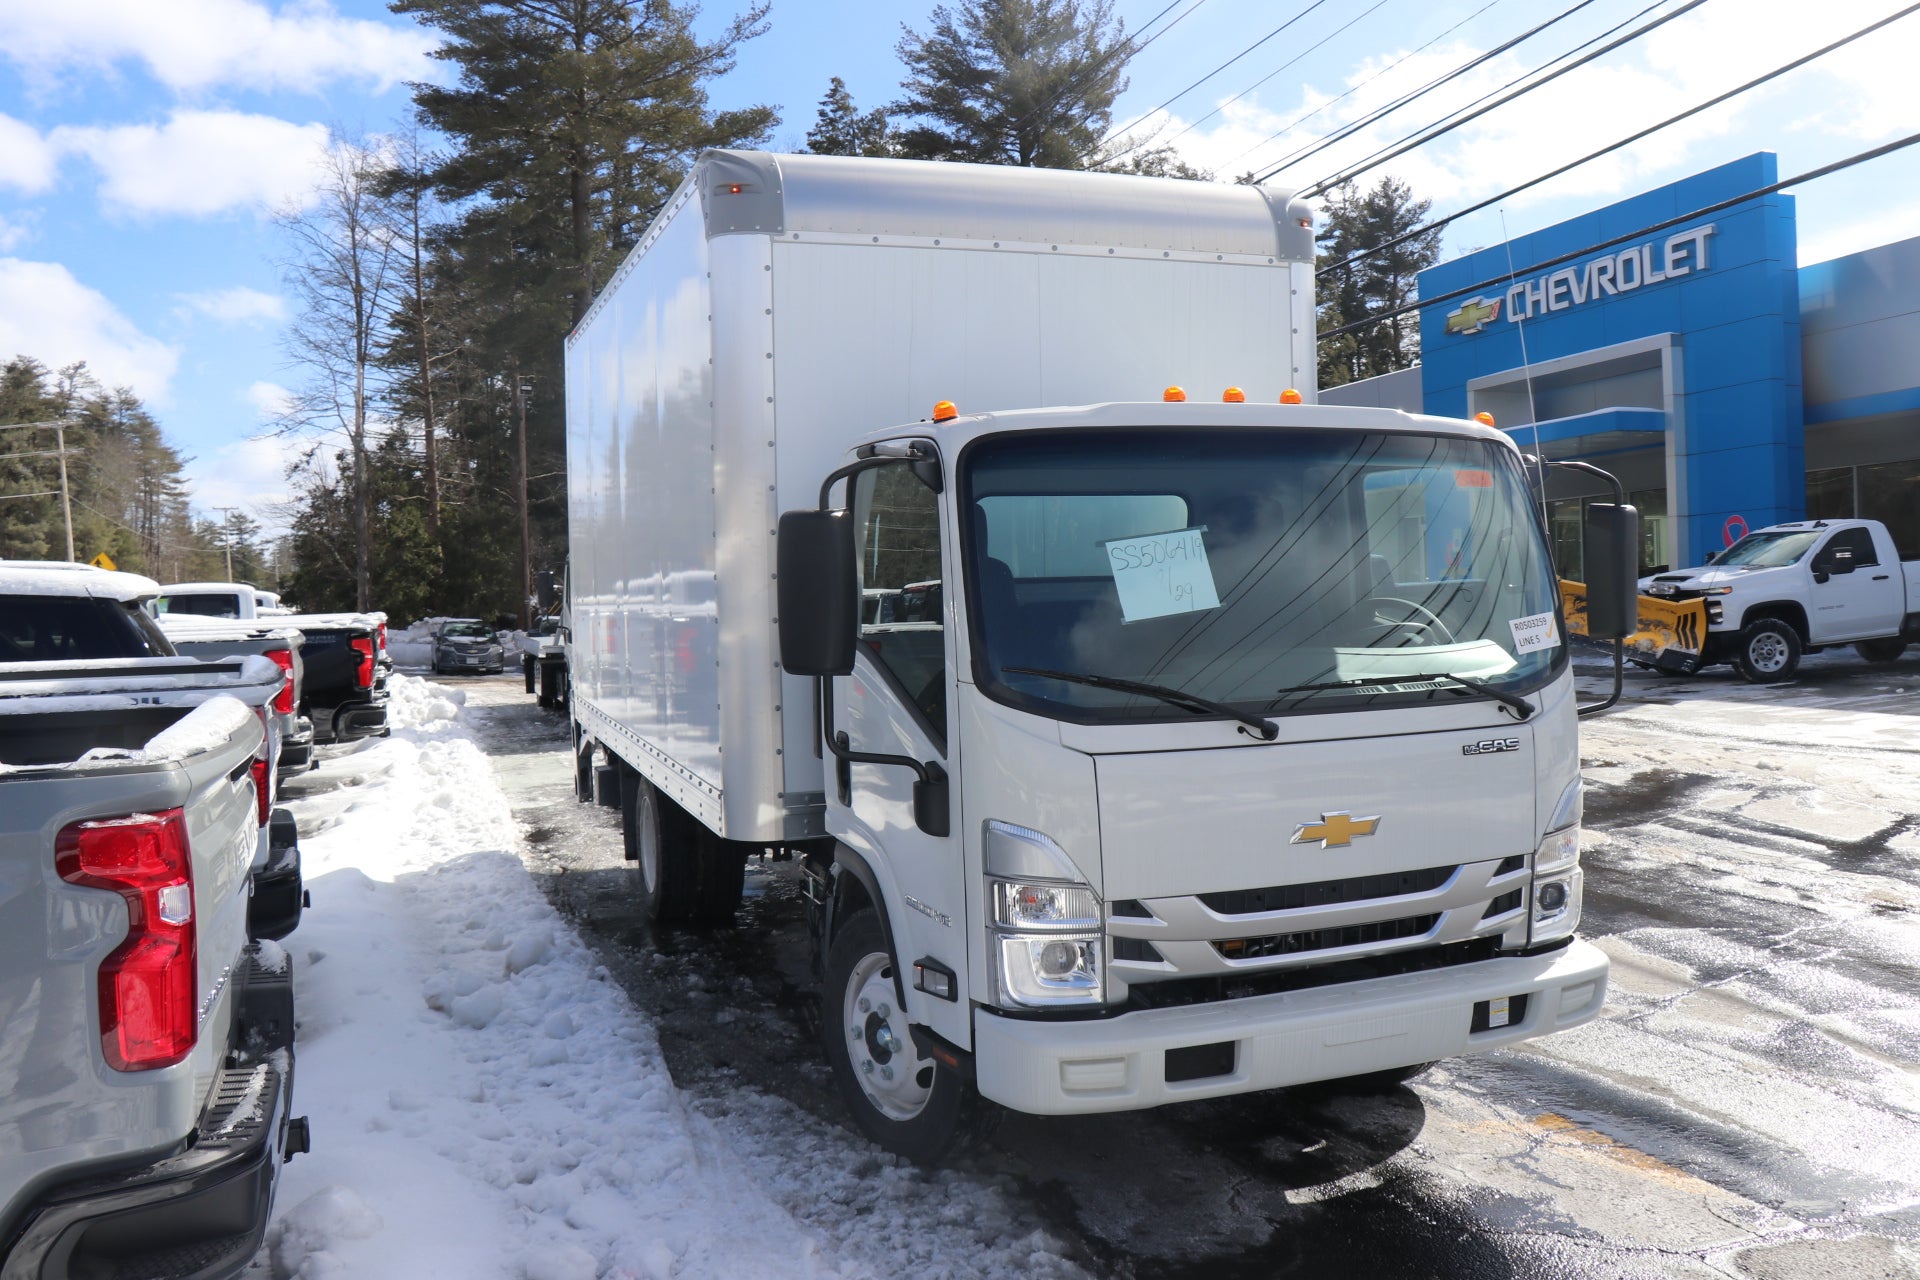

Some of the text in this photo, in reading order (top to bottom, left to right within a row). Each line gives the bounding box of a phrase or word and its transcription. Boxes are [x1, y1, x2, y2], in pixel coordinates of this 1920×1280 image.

[1506, 224, 1714, 322] CHEVROLET
[1519, 635, 1535, 647] LINE
[1479, 738, 1520, 752] GAS
